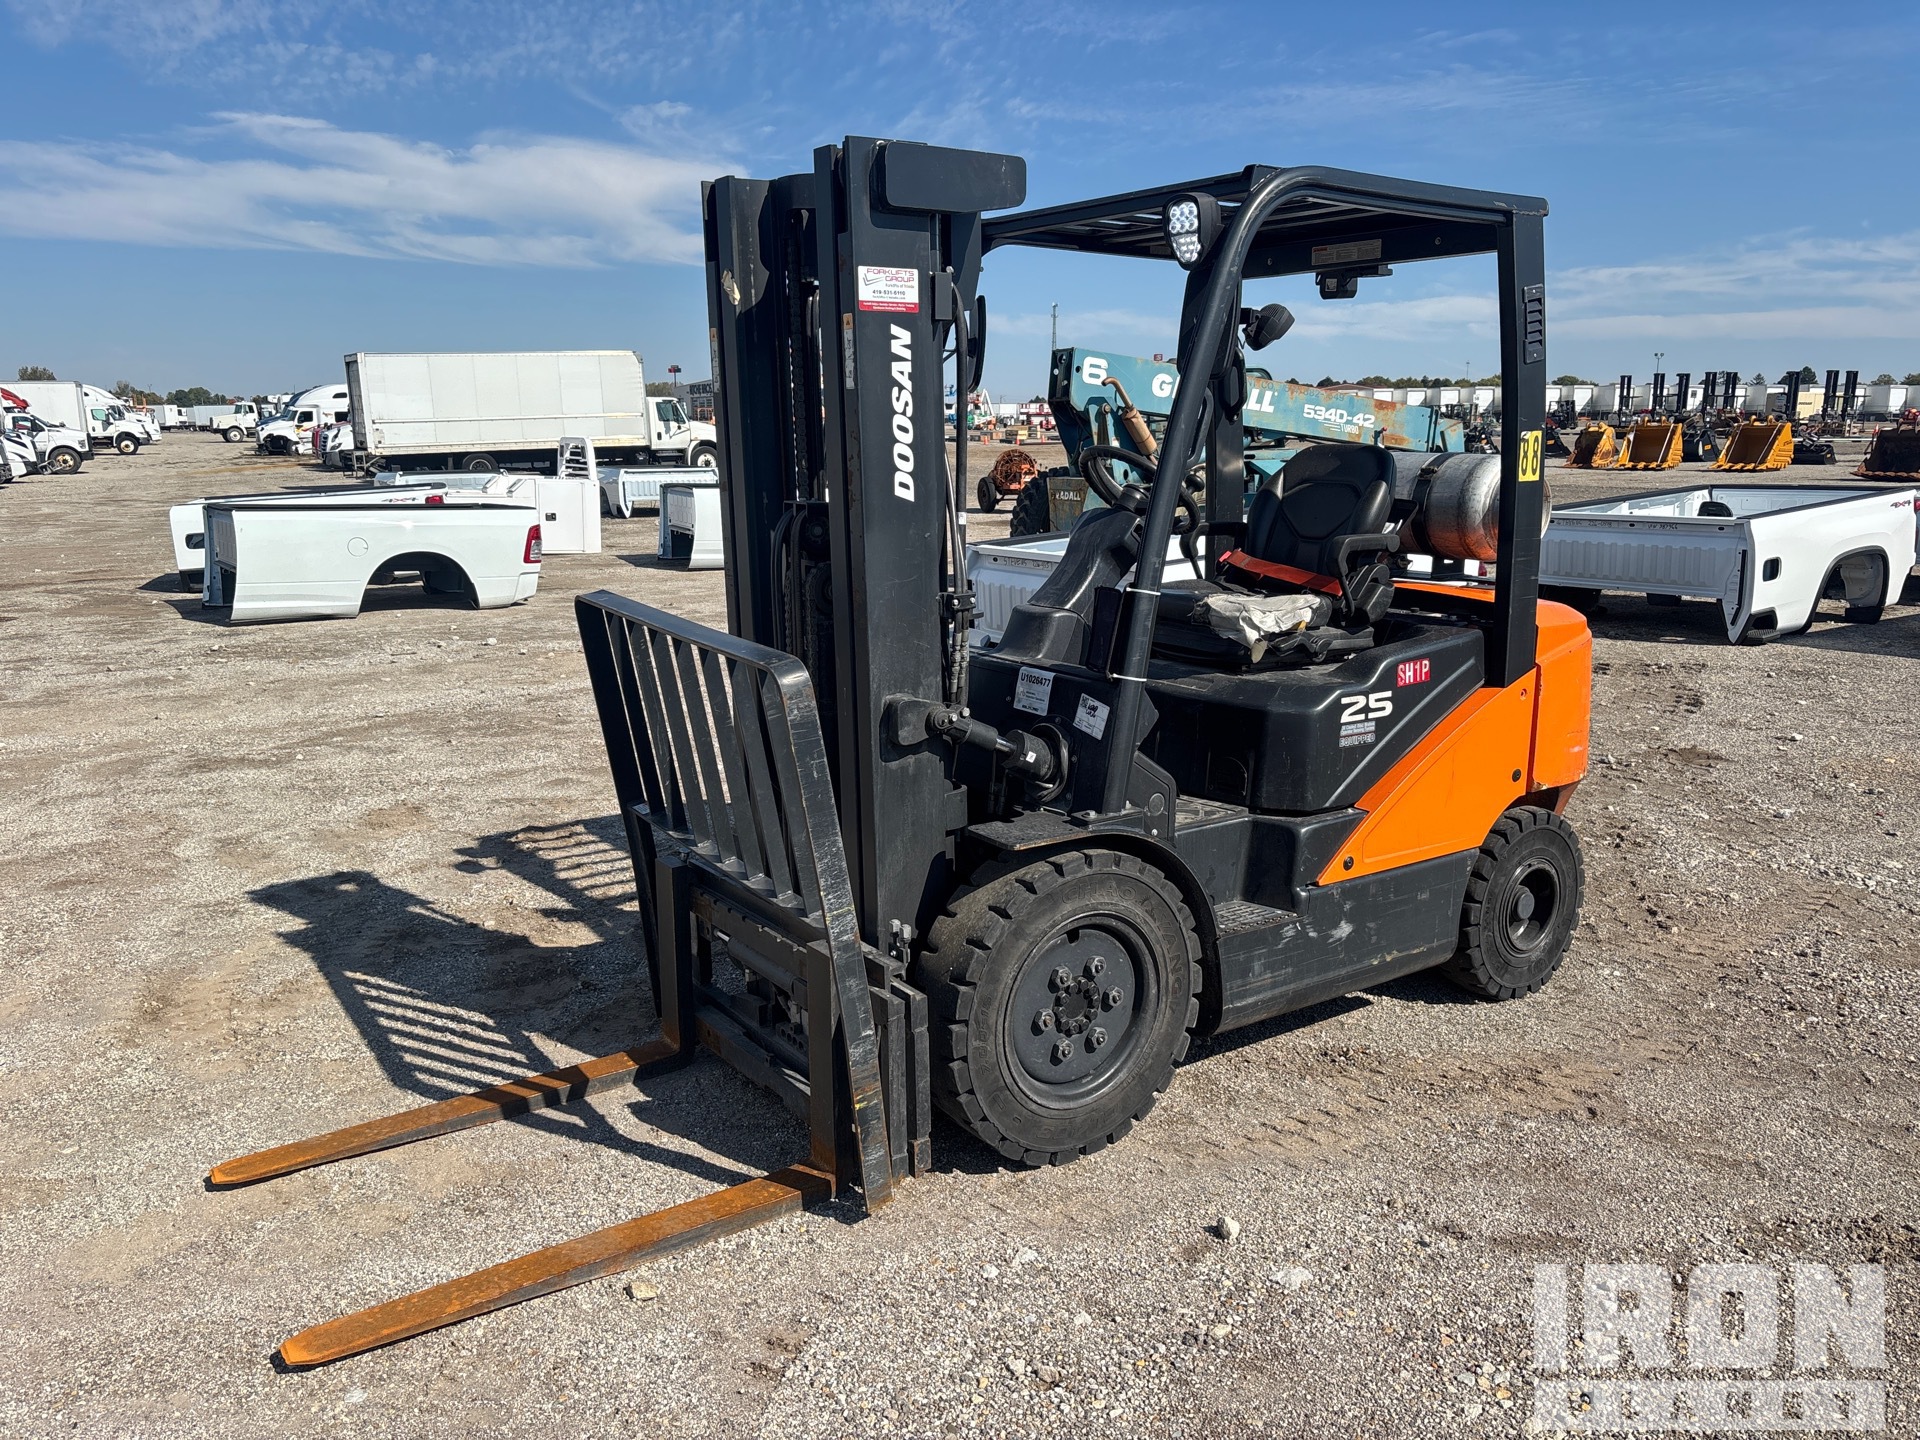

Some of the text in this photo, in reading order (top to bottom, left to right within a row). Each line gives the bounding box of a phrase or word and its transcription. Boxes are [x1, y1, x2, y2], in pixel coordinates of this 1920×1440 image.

[866, 268, 915, 277] FORKLIFTS
[1082, 356, 1108, 386] 6
[890, 323, 915, 502] DOOSAN
[1303, 403, 1376, 429] 534D-42
[1340, 423, 1359, 435] TURBO
[1020, 672, 1051, 688] U1026477
[1340, 690, 1393, 723] 25
[1339, 733, 1376, 748] EQUIPPED
